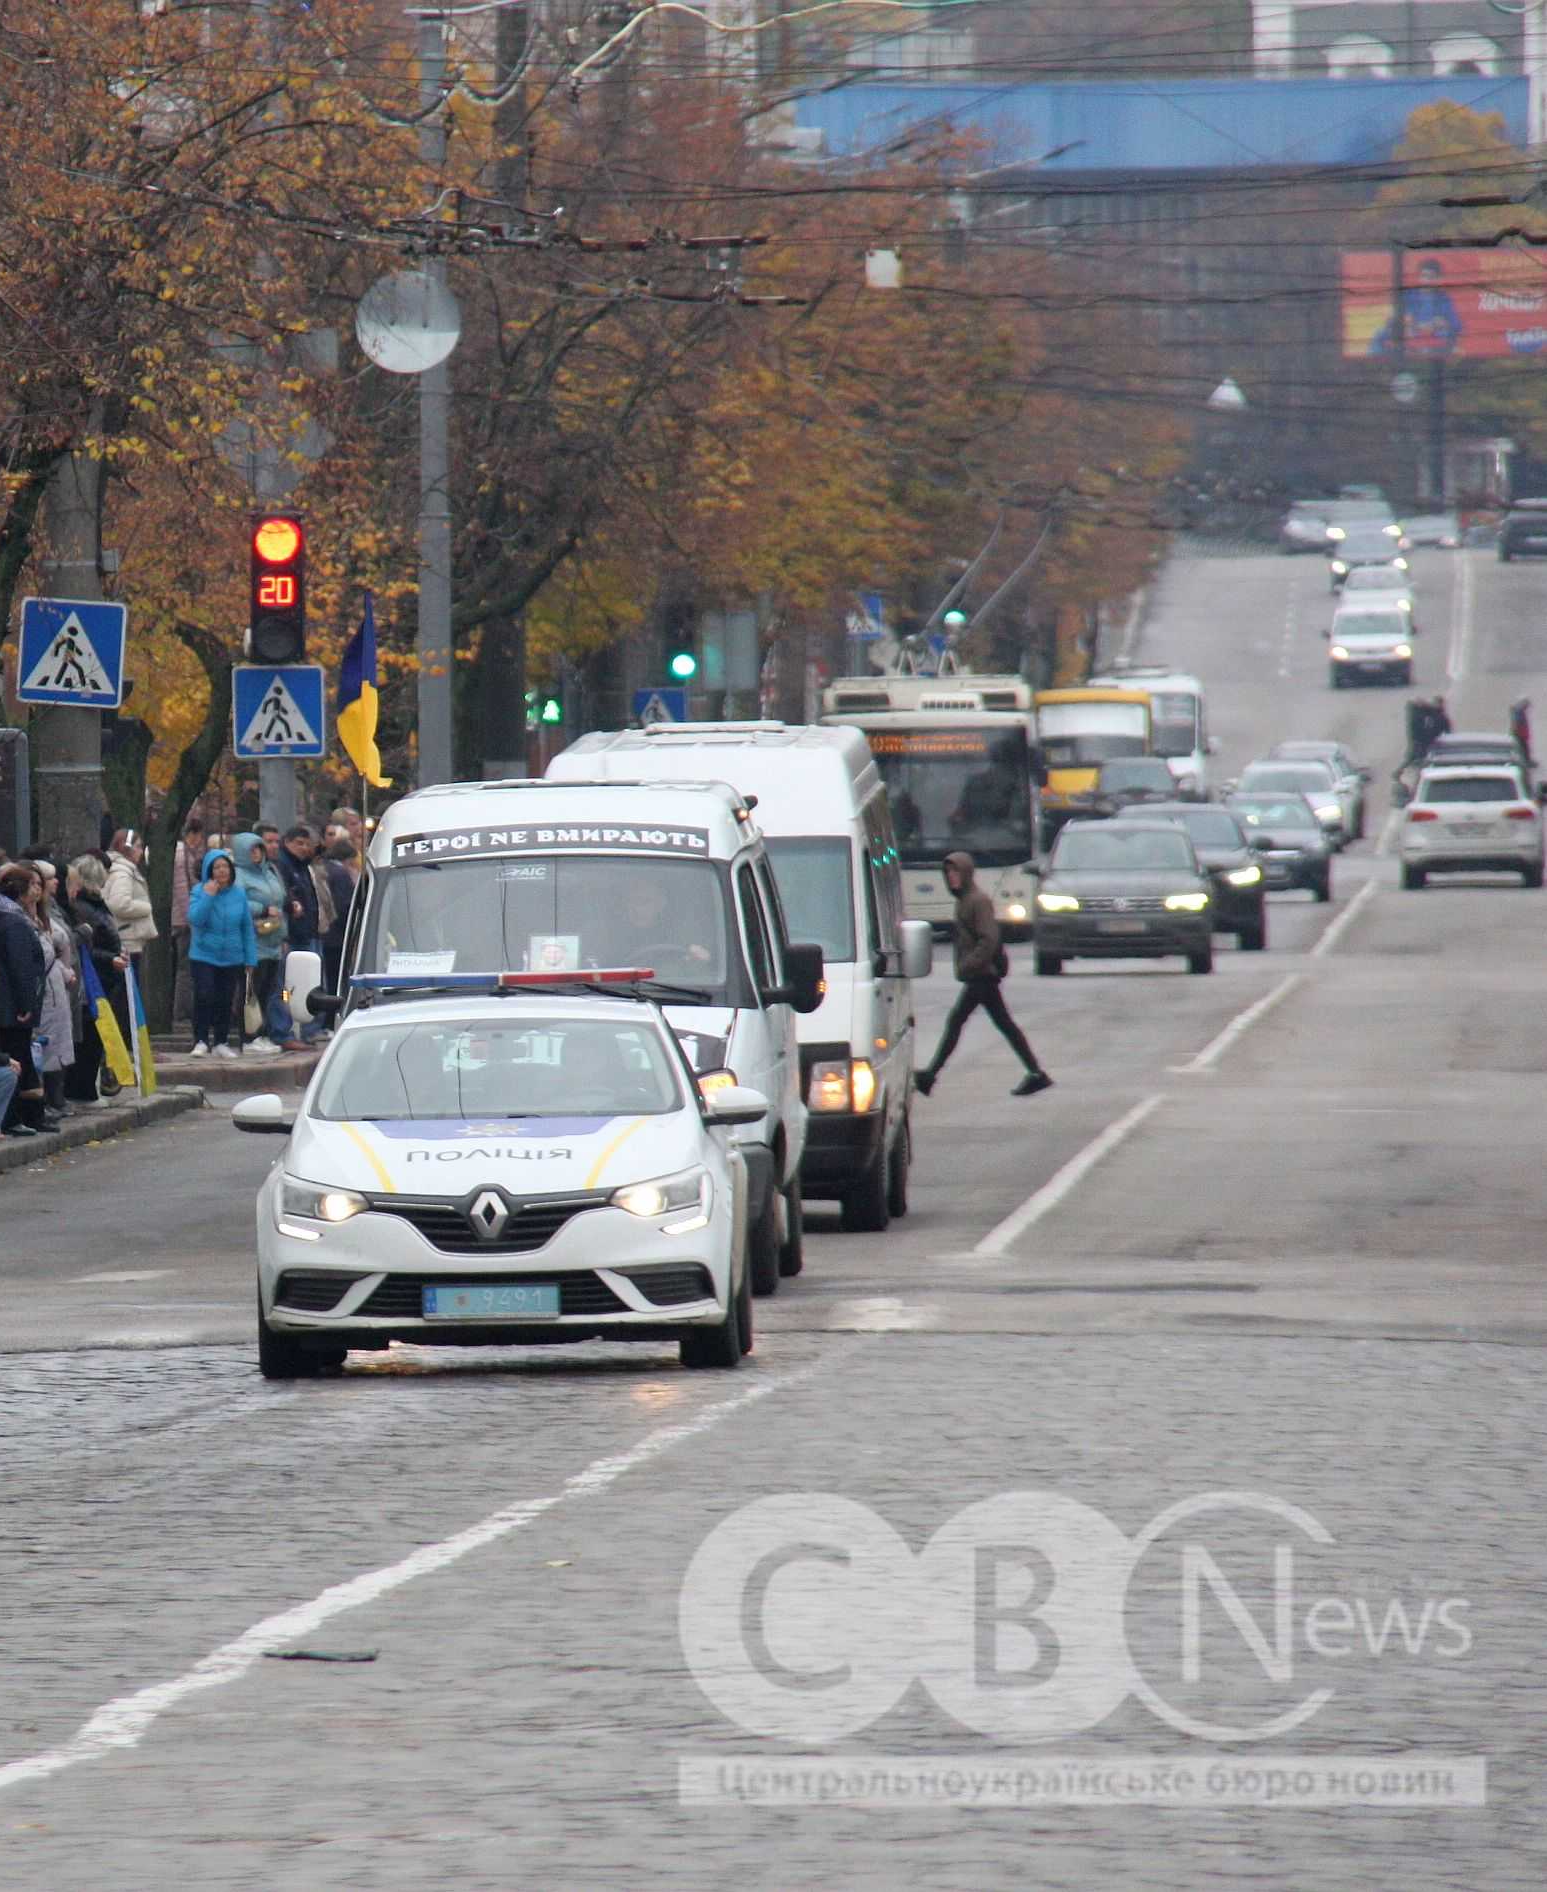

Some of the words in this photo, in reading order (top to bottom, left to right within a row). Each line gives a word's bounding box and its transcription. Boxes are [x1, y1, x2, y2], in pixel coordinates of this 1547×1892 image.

[259, 576, 294, 604] 20
[396, 831, 481, 857] ГЕРОЇ
[536, 829, 705, 848] ВМИРАЮТЬ
[406, 1148, 573, 1163] ПОЛІЦІЯ
